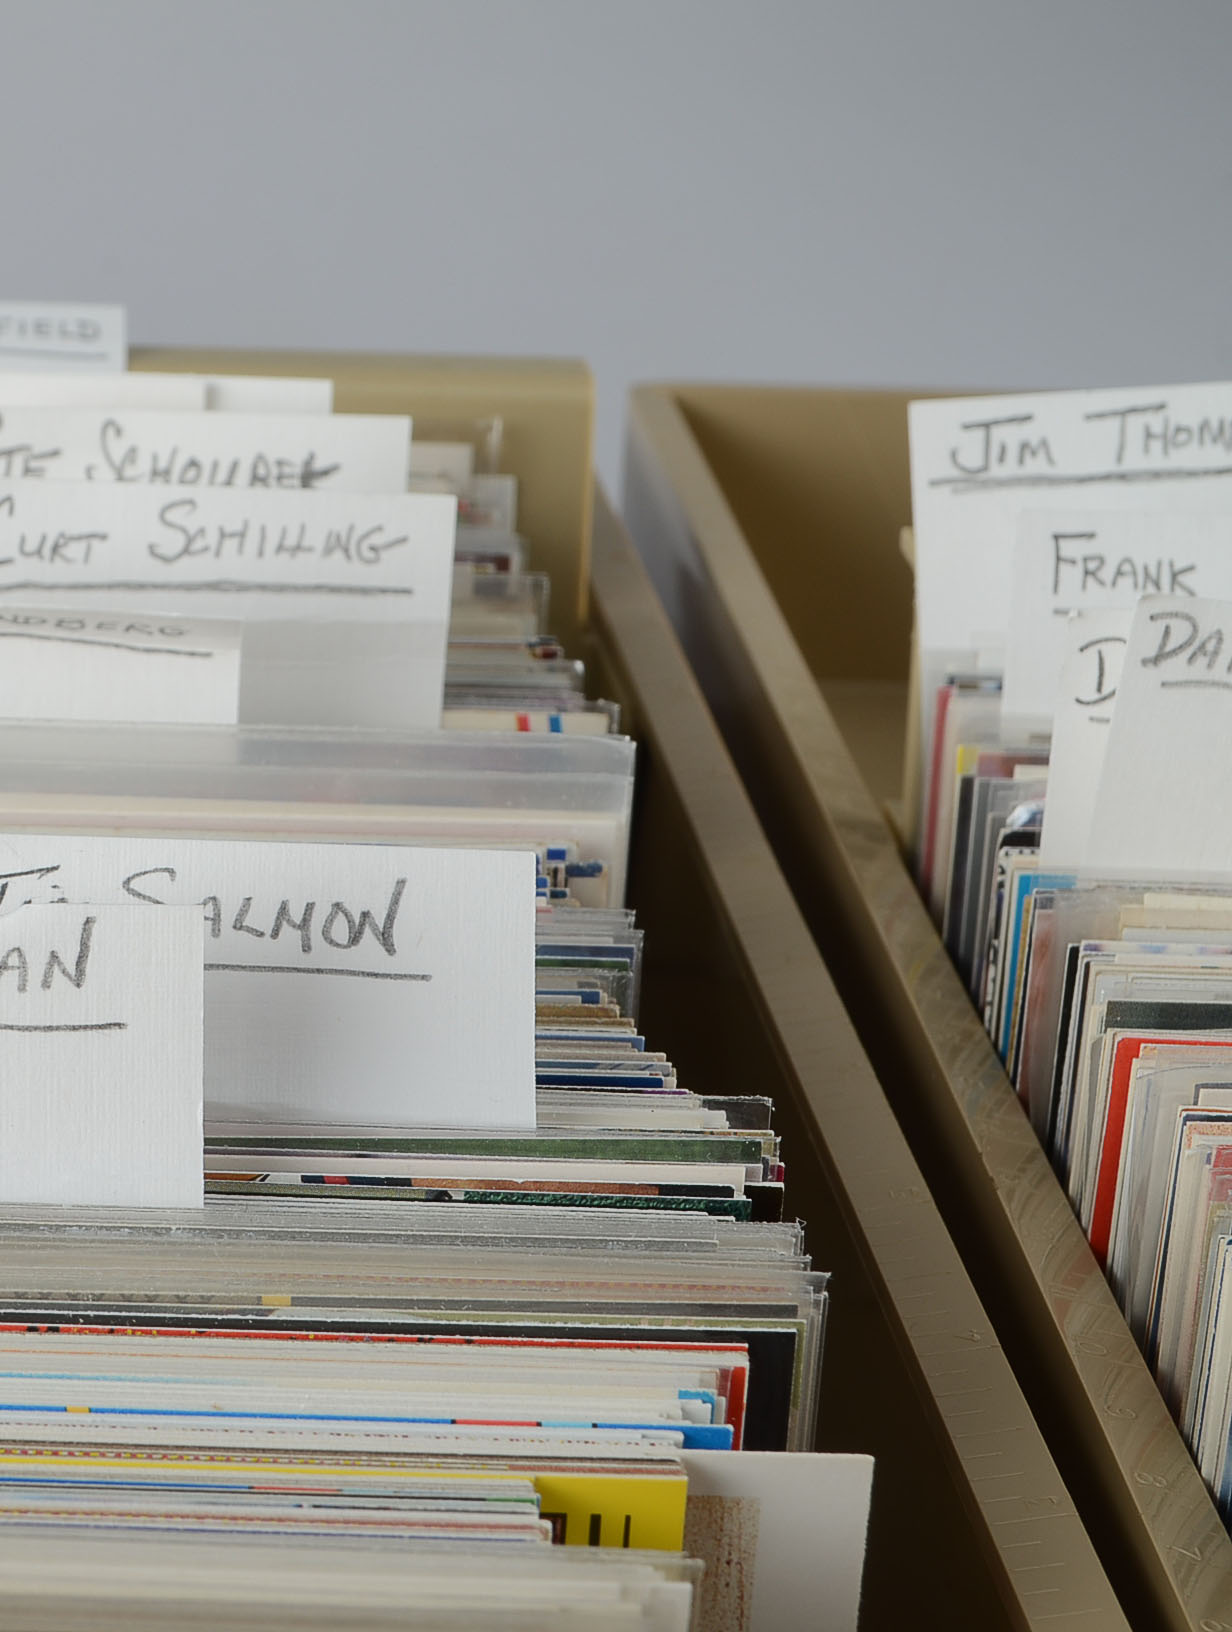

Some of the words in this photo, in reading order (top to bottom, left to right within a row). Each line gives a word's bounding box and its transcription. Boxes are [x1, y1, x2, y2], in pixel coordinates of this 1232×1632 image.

[950, 413, 1057, 475] JIM
[147, 499, 410, 567] SCHILLING
[1051, 532, 1197, 598] FRANK
[1140, 610, 1232, 674] DA
